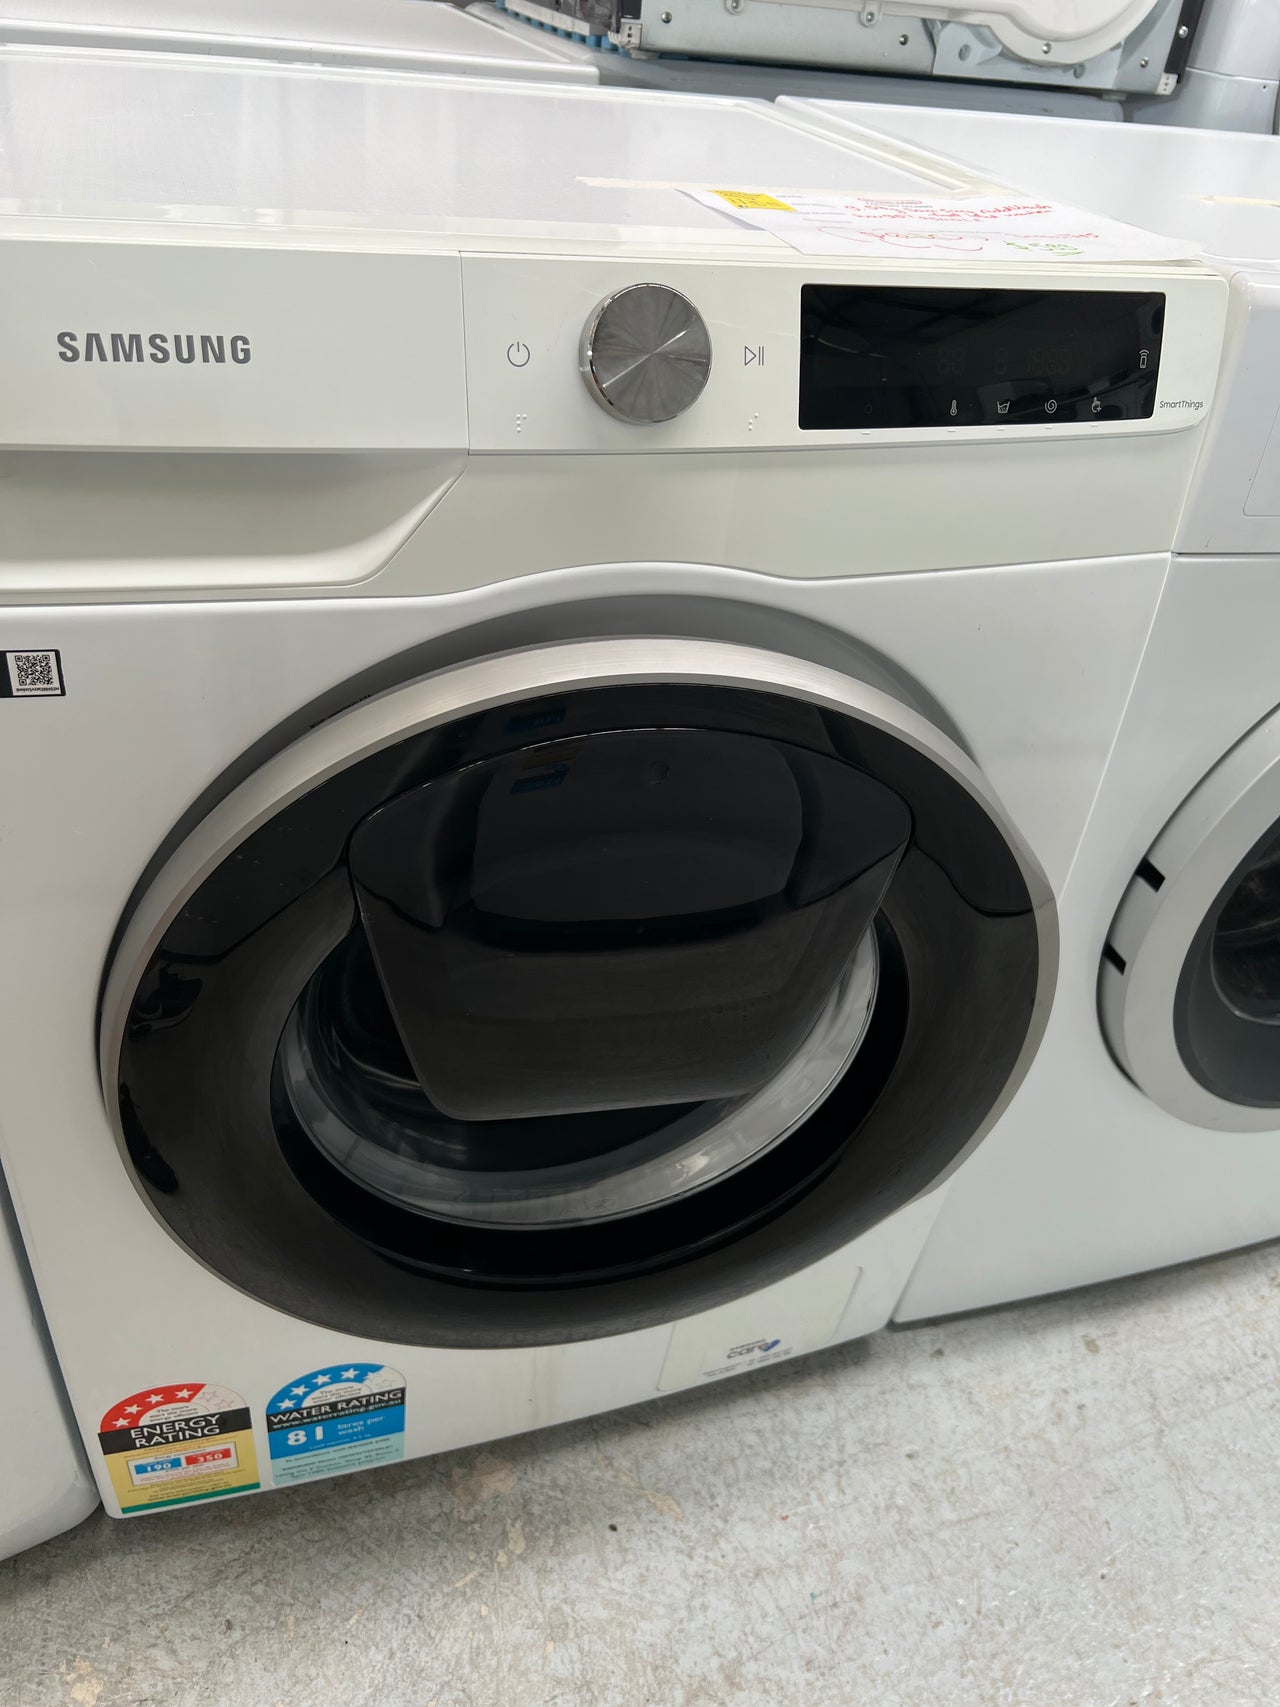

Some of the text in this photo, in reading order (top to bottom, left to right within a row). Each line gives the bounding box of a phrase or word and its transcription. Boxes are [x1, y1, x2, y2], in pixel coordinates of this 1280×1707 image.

[57, 331, 251, 365] SAMSUNG
[1159, 400, 1204, 411] SmartThings
[270, 1390, 402, 1423] WATER RATING
[130, 1414, 221, 1440] ENERGY
[337, 1420, 364, 1431] litres
[337, 1426, 365, 1435] wash
[135, 1425, 221, 1448] RATING
[146, 1462, 172, 1472] 190
[197, 1452, 223, 1463] 350
